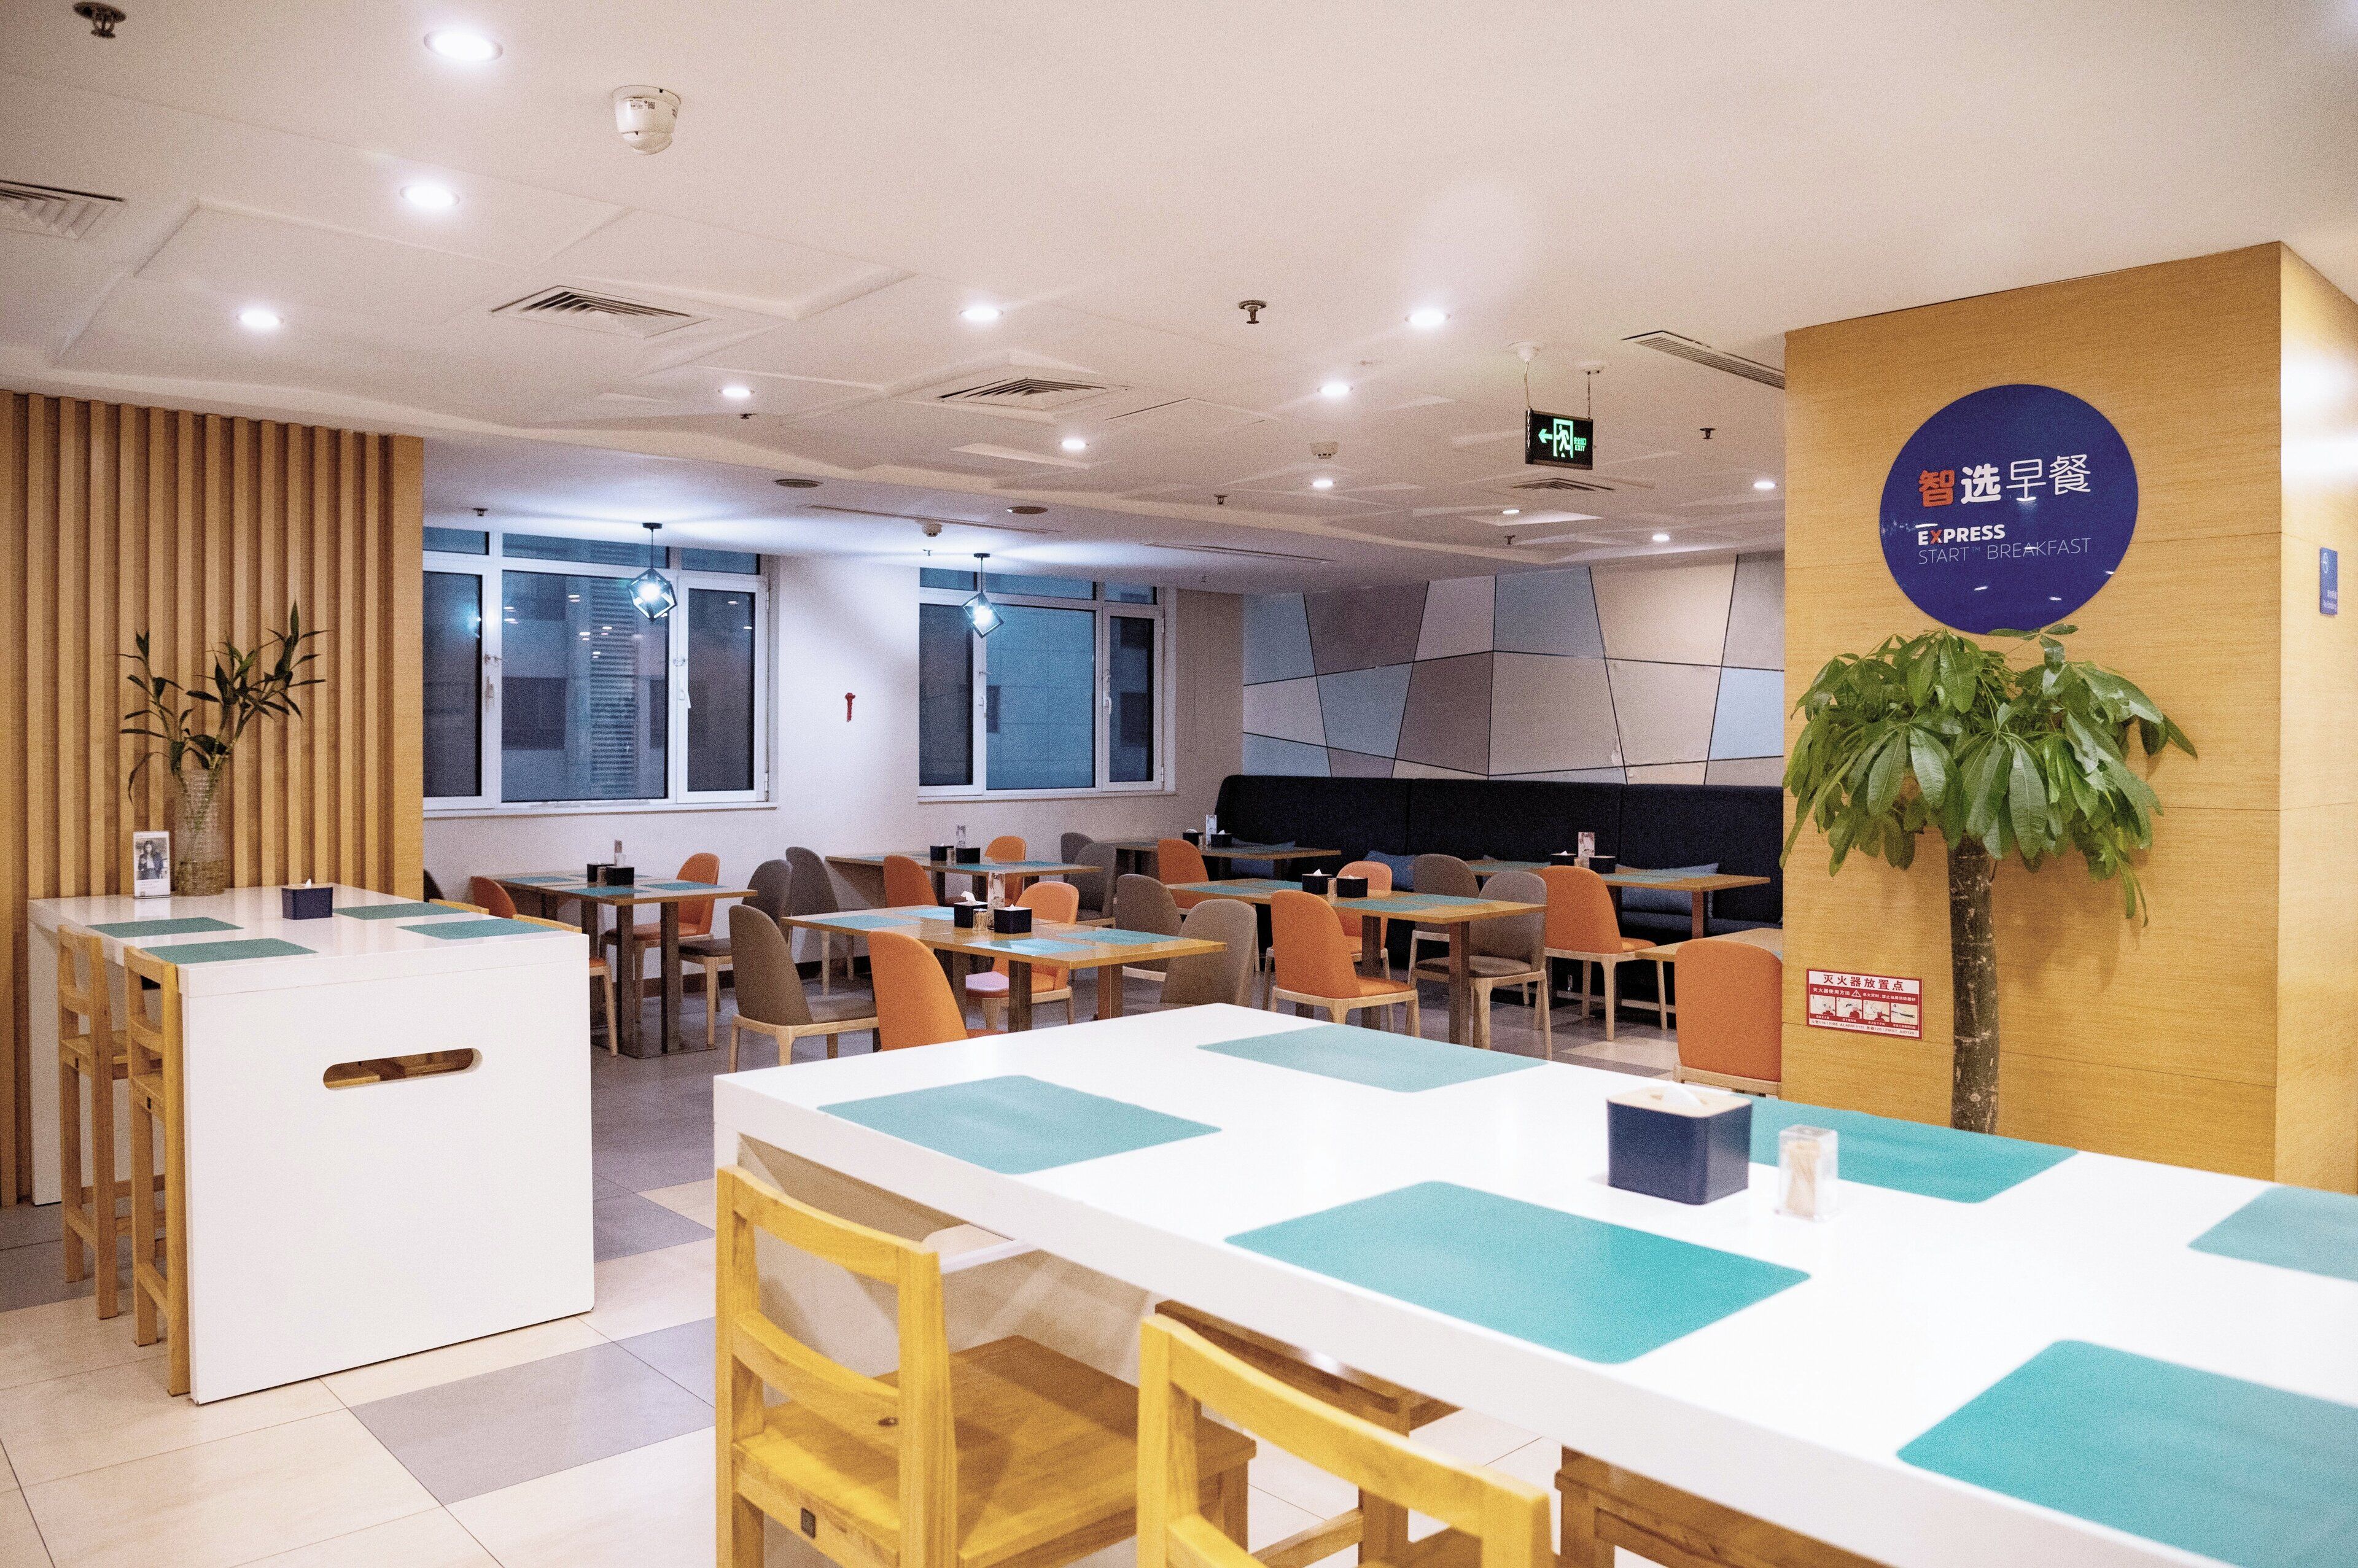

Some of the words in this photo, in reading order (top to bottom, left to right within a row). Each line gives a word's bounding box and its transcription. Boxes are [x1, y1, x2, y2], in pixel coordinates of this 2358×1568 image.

[1918, 454, 2091, 508] 智选早餐
[1918, 524, 2006, 546] EXPRESS
[1987, 537, 2091, 560] BREAKFAST
[1813, 987, 1850, 996] 灭火器使用方法
[1823, 974, 1904, 992] 灭火器放置点
